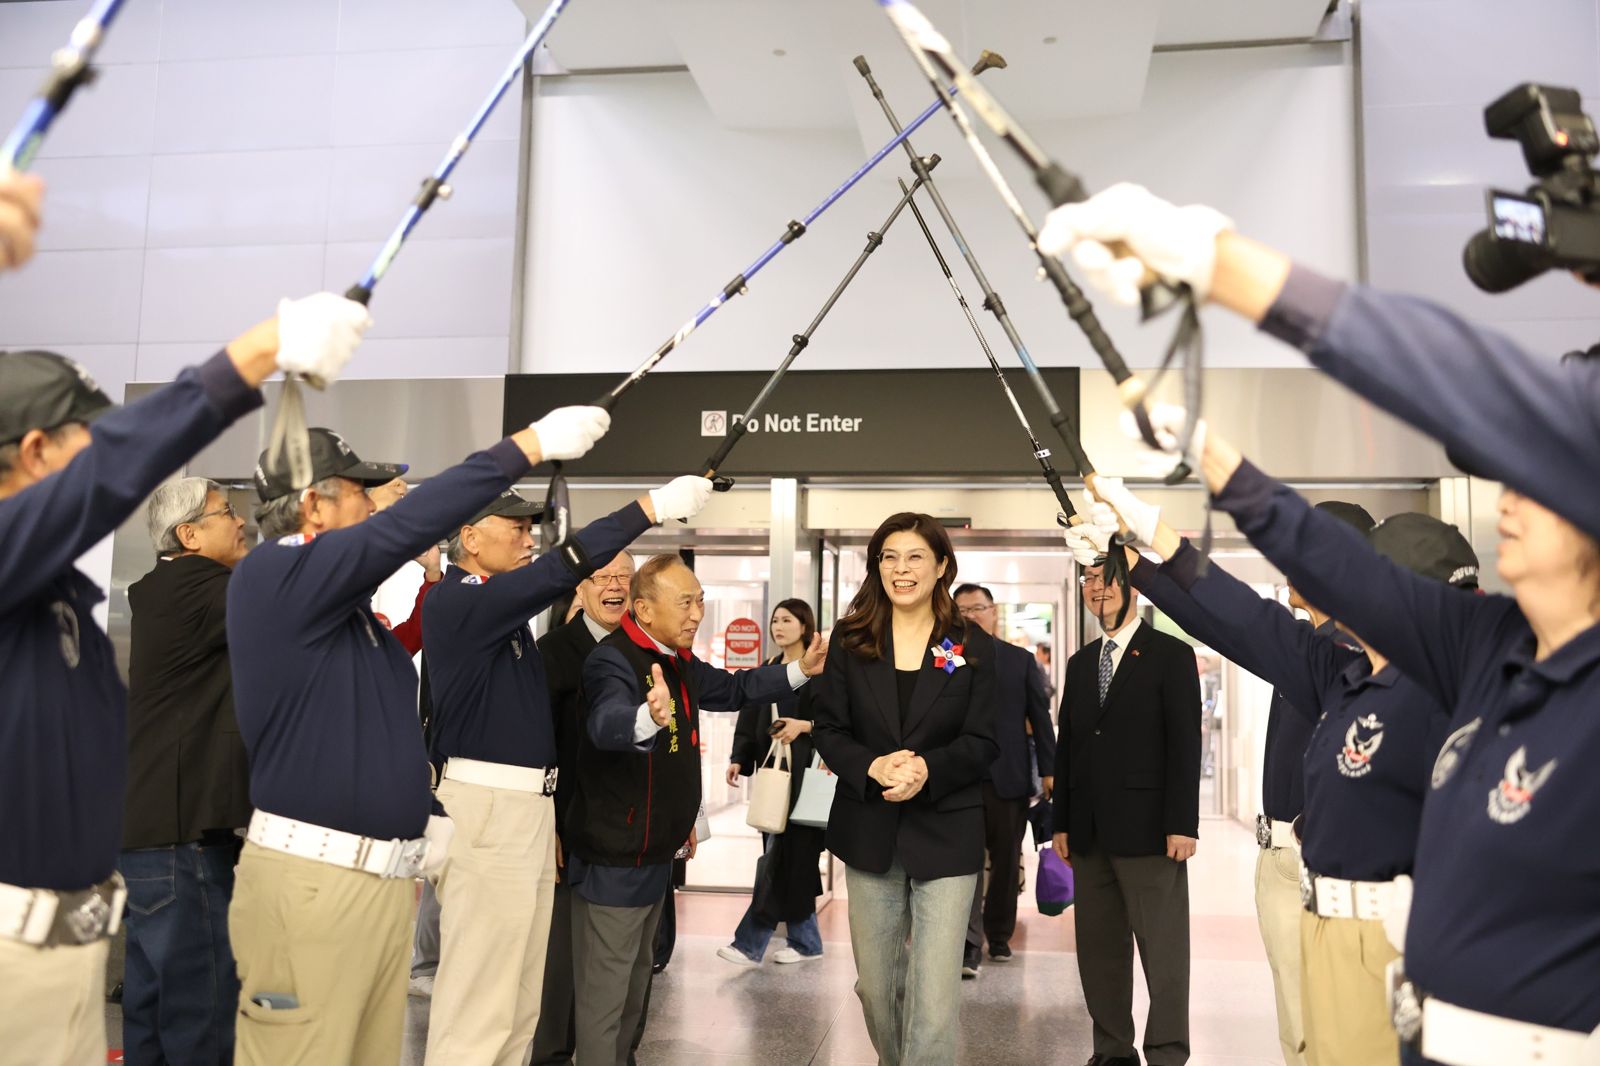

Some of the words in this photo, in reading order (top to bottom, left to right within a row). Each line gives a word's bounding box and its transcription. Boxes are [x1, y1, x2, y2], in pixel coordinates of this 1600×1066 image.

[765, 413, 802, 433] Not
[806, 413, 862, 433] Enter
[729, 624, 740, 633] DO
[741, 624, 756, 633] NOT
[730, 640, 755, 649] ENTER
